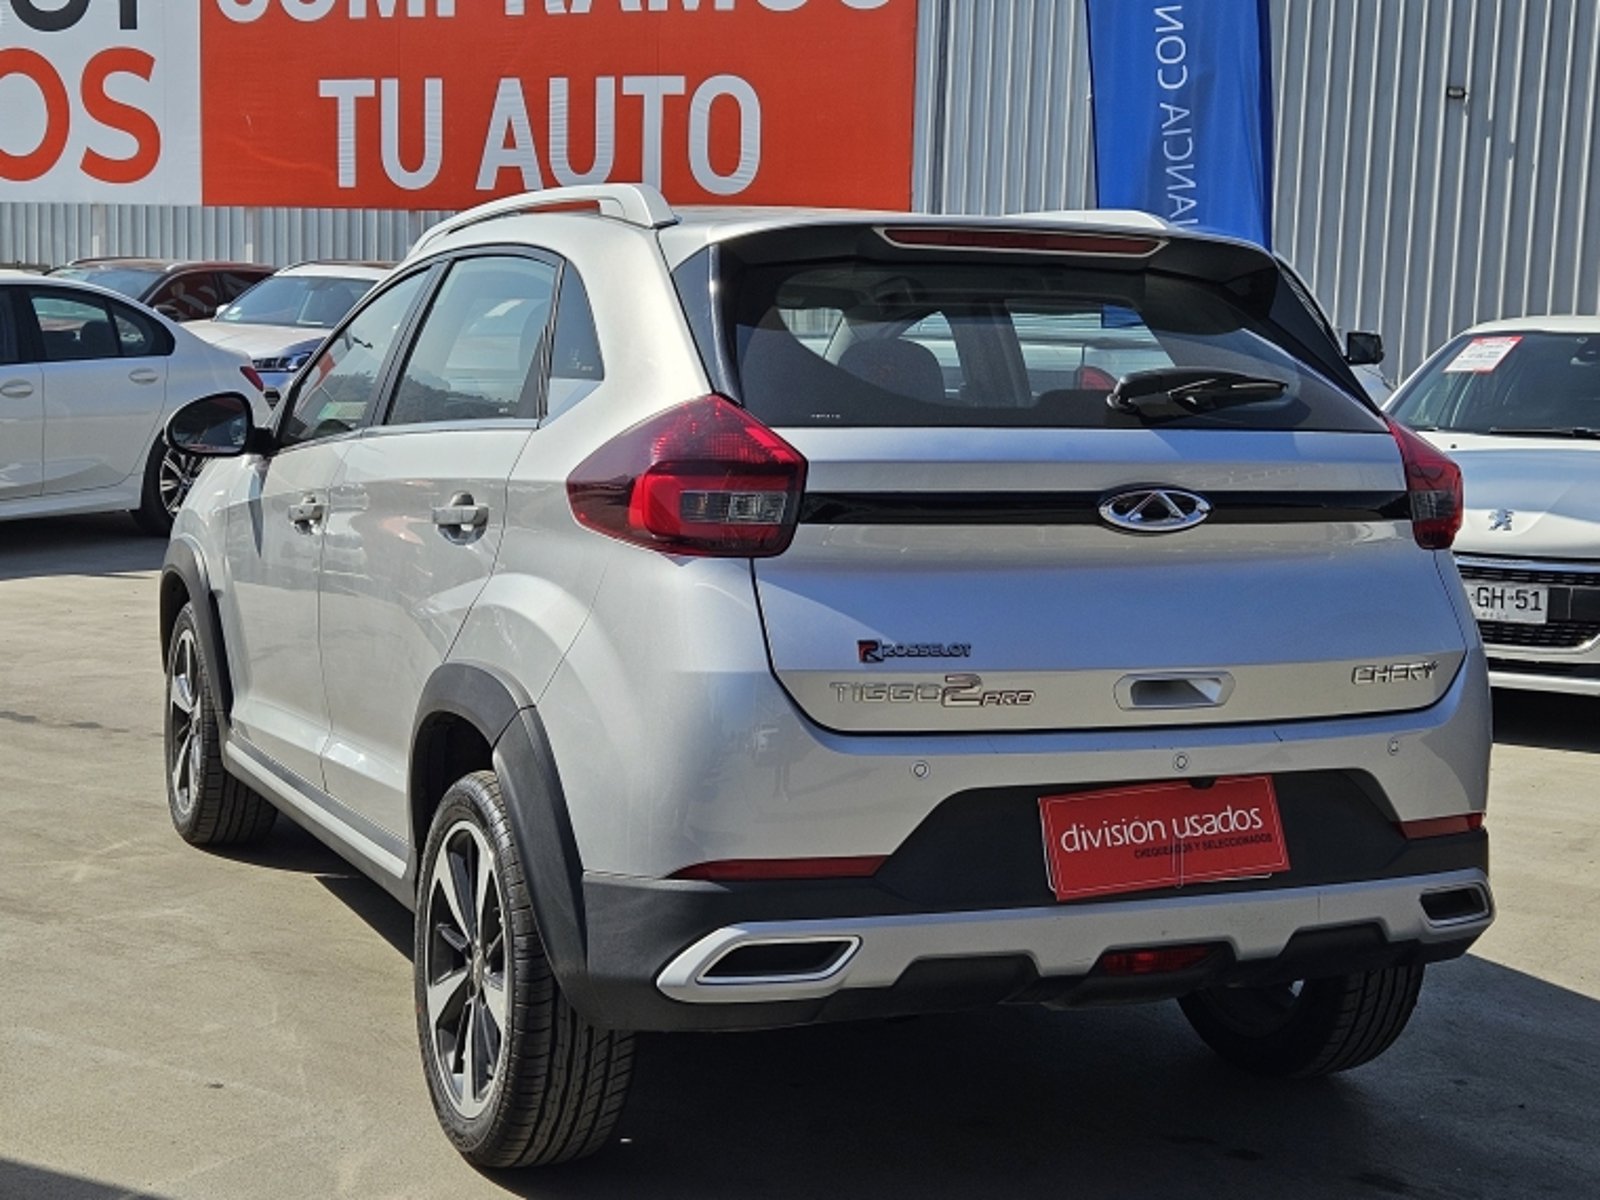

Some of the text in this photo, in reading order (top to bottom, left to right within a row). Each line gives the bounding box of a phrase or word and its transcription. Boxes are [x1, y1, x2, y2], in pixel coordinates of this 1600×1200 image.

[318, 73, 762, 195] TU AUTO
[1351, 661, 1439, 685] CHERY
[1060, 804, 1264, 853] división usados
